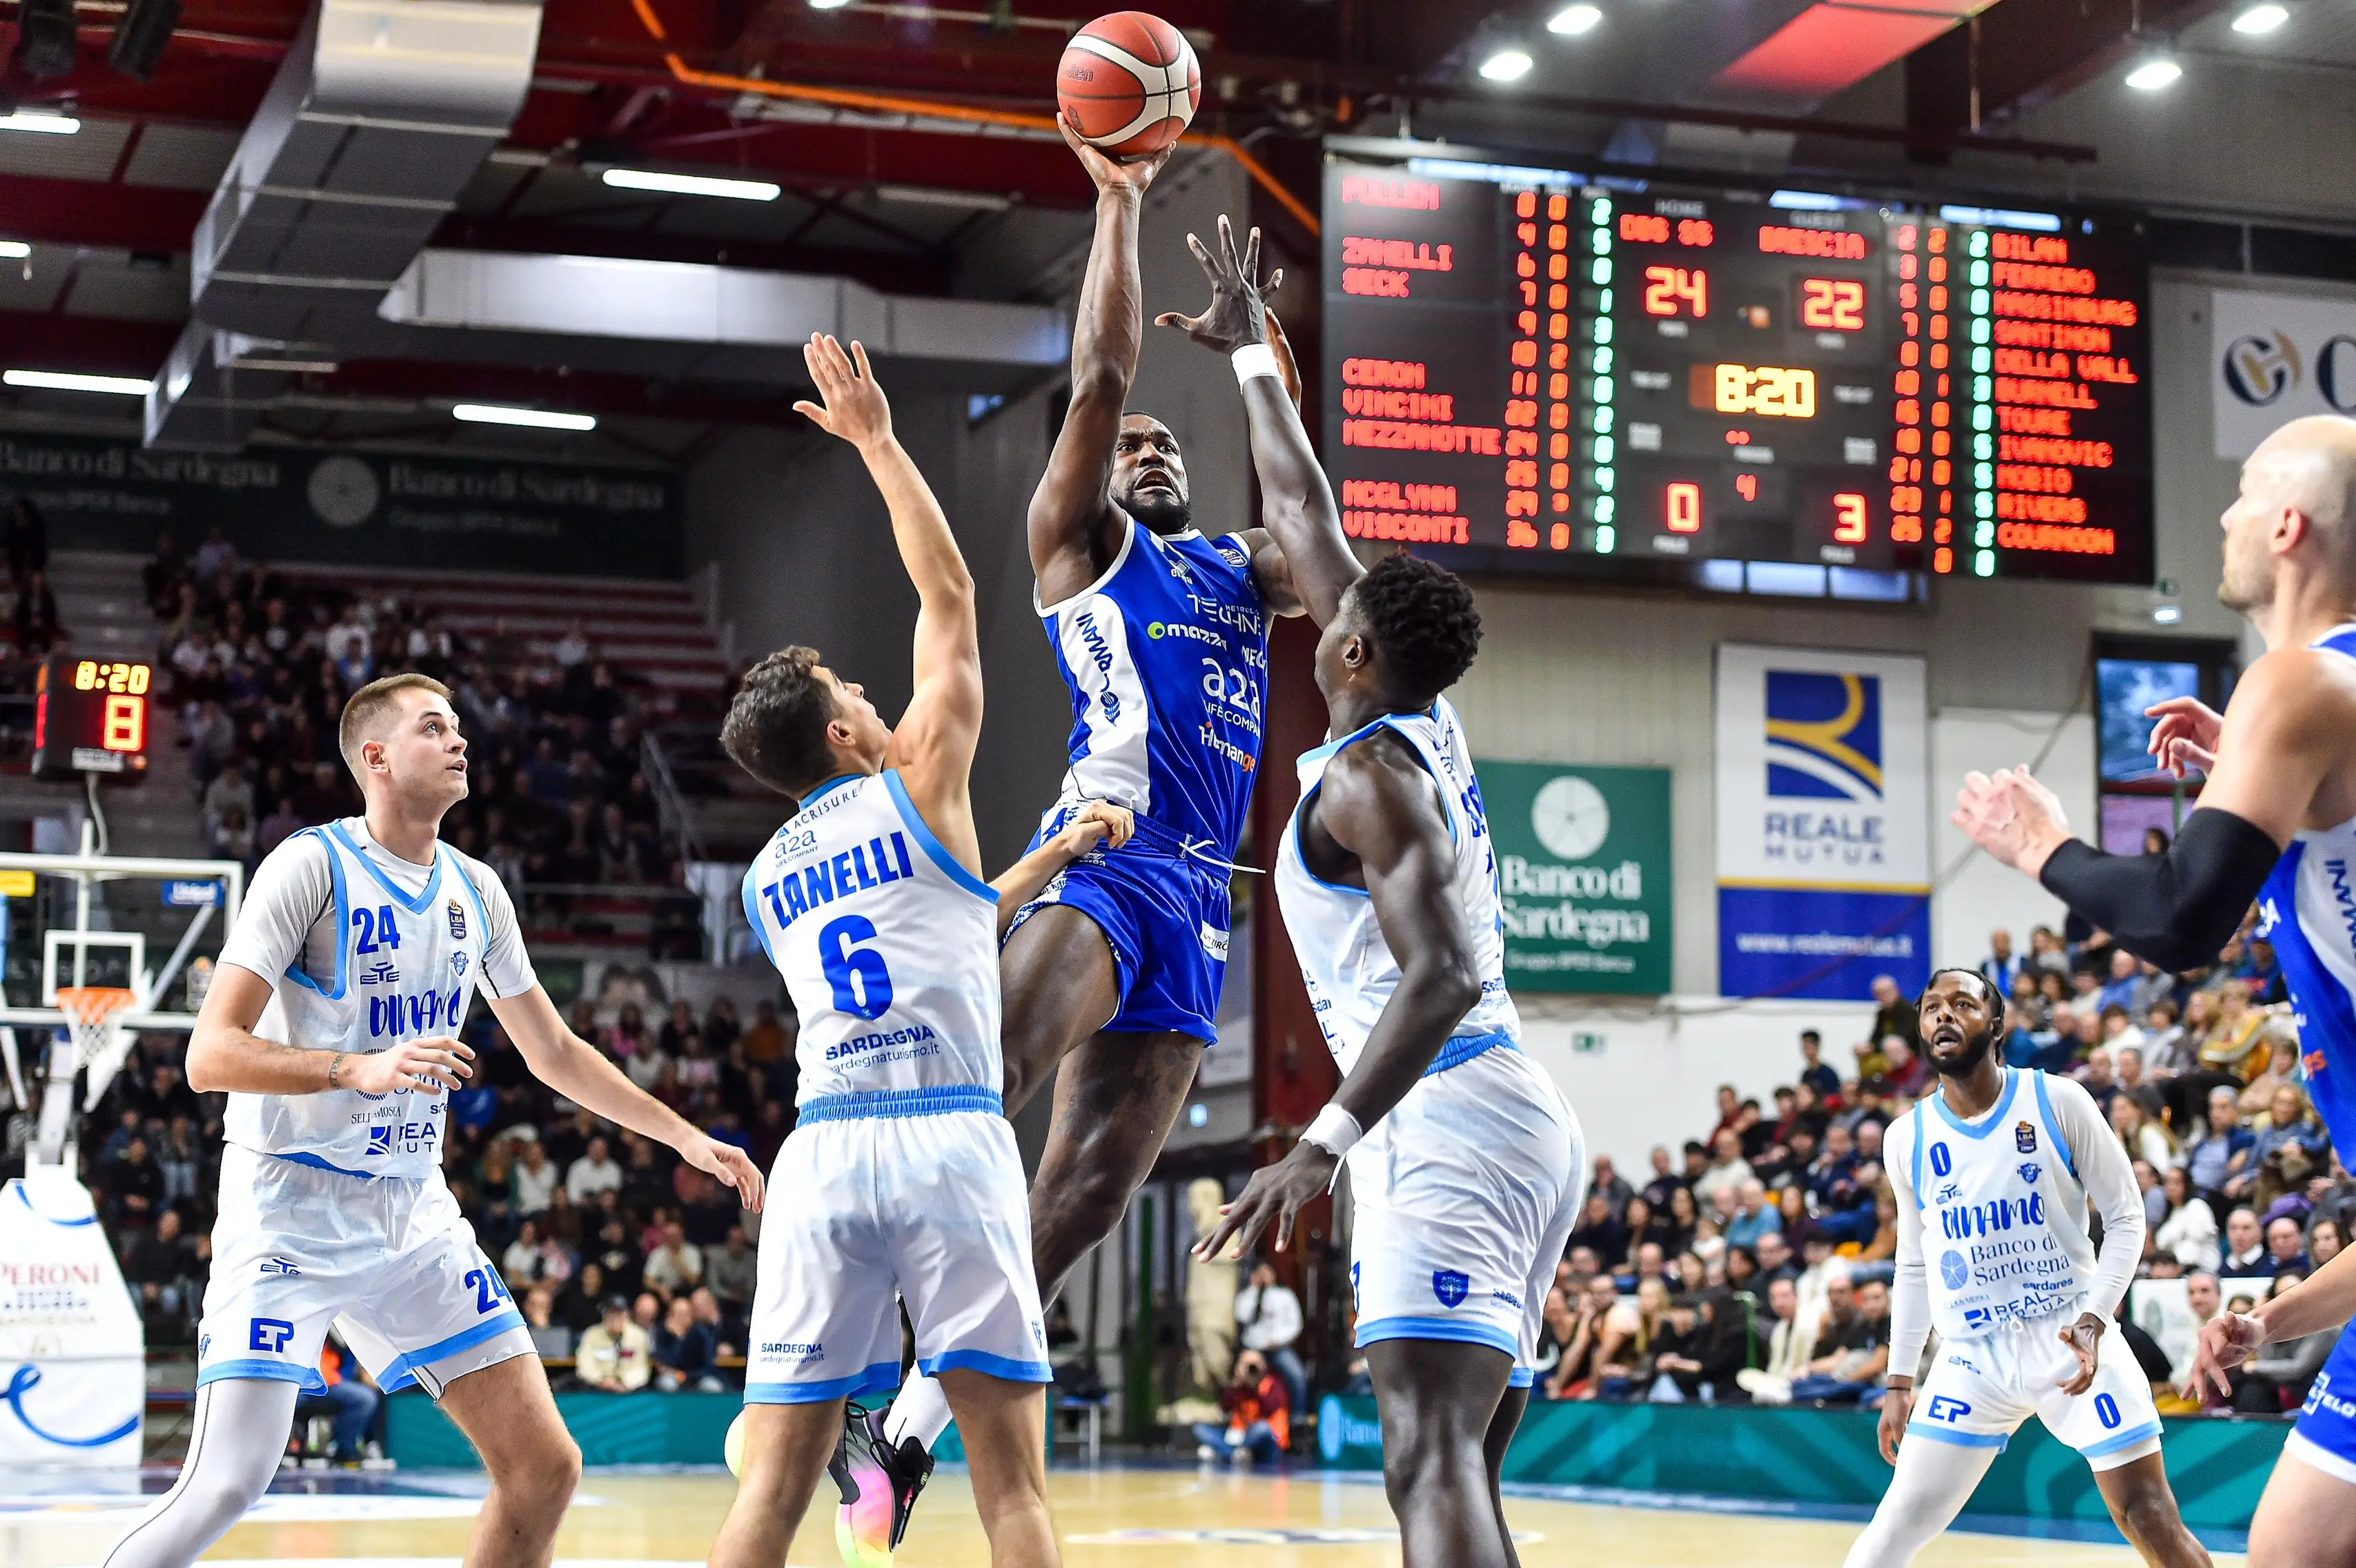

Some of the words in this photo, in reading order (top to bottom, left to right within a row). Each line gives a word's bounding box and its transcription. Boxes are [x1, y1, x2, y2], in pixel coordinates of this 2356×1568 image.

[1342, 177, 1440, 210] PULLEN
[1517, 222, 1537, 247] 4
[1896, 224, 1918, 252] 2
[1927, 227, 1947, 254] 2
[1969, 231, 1989, 258] 2
[1342, 236, 1453, 272] ZANELLI
[1517, 251, 1536, 278] 6
[1898, 253, 1918, 281] 3
[1519, 280, 1537, 306] 7
[1600, 288, 1613, 313] 1
[1645, 266, 1707, 318] 24
[1803, 278, 1865, 331] 22
[1899, 282, 1918, 309] 5
[1901, 311, 1919, 337] 7
[1549, 343, 1569, 370] 2
[1511, 371, 1538, 396] 11
[1715, 363, 1815, 418] 8:20
[1937, 373, 1950, 397] 1
[1594, 467, 1615, 493] 4
[1890, 456, 1922, 484] 21
[1665, 483, 1701, 533] 0
[1833, 493, 1867, 544] 3
[1939, 490, 1952, 514] 1
[1342, 510, 1469, 545] VISCONTI
[1933, 518, 1952, 545] 2
[1974, 520, 1994, 548] 2
[75, 660, 150, 695] 8:20
[104, 695, 144, 751] 8
[794, 788, 858, 830] ACRISURE
[775, 830, 817, 859] a2a
[1765, 812, 1885, 844] REALE
[1765, 843, 1886, 865] MUTUA
[762, 830, 914, 930] ZANELLI
[1501, 854, 1608, 899] Banco
[1609, 859, 1642, 900] di
[351, 905, 401, 955] 24
[1502, 899, 1651, 950] Sardegna
[818, 914, 894, 1021] 6
[825, 1025, 936, 1061] SARDEGNA
[1930, 1141, 1952, 1177] 0
[1941, 1191, 2045, 1241] DINAMO
[1970, 1238, 2036, 1265] Banco
[2041, 1231, 2059, 1251] di
[1974, 1253, 2070, 1288] Sardegna
[2022, 1277, 2074, 1292] sardares
[464, 1263, 513, 1316] 24
[1994, 1291, 2051, 1317] REAL
[249, 1317, 295, 1353] EP
[760, 1342, 823, 1353] SARDEGNA
[1927, 1395, 1972, 1423] EP
[2094, 1393, 2121, 1430] 0
